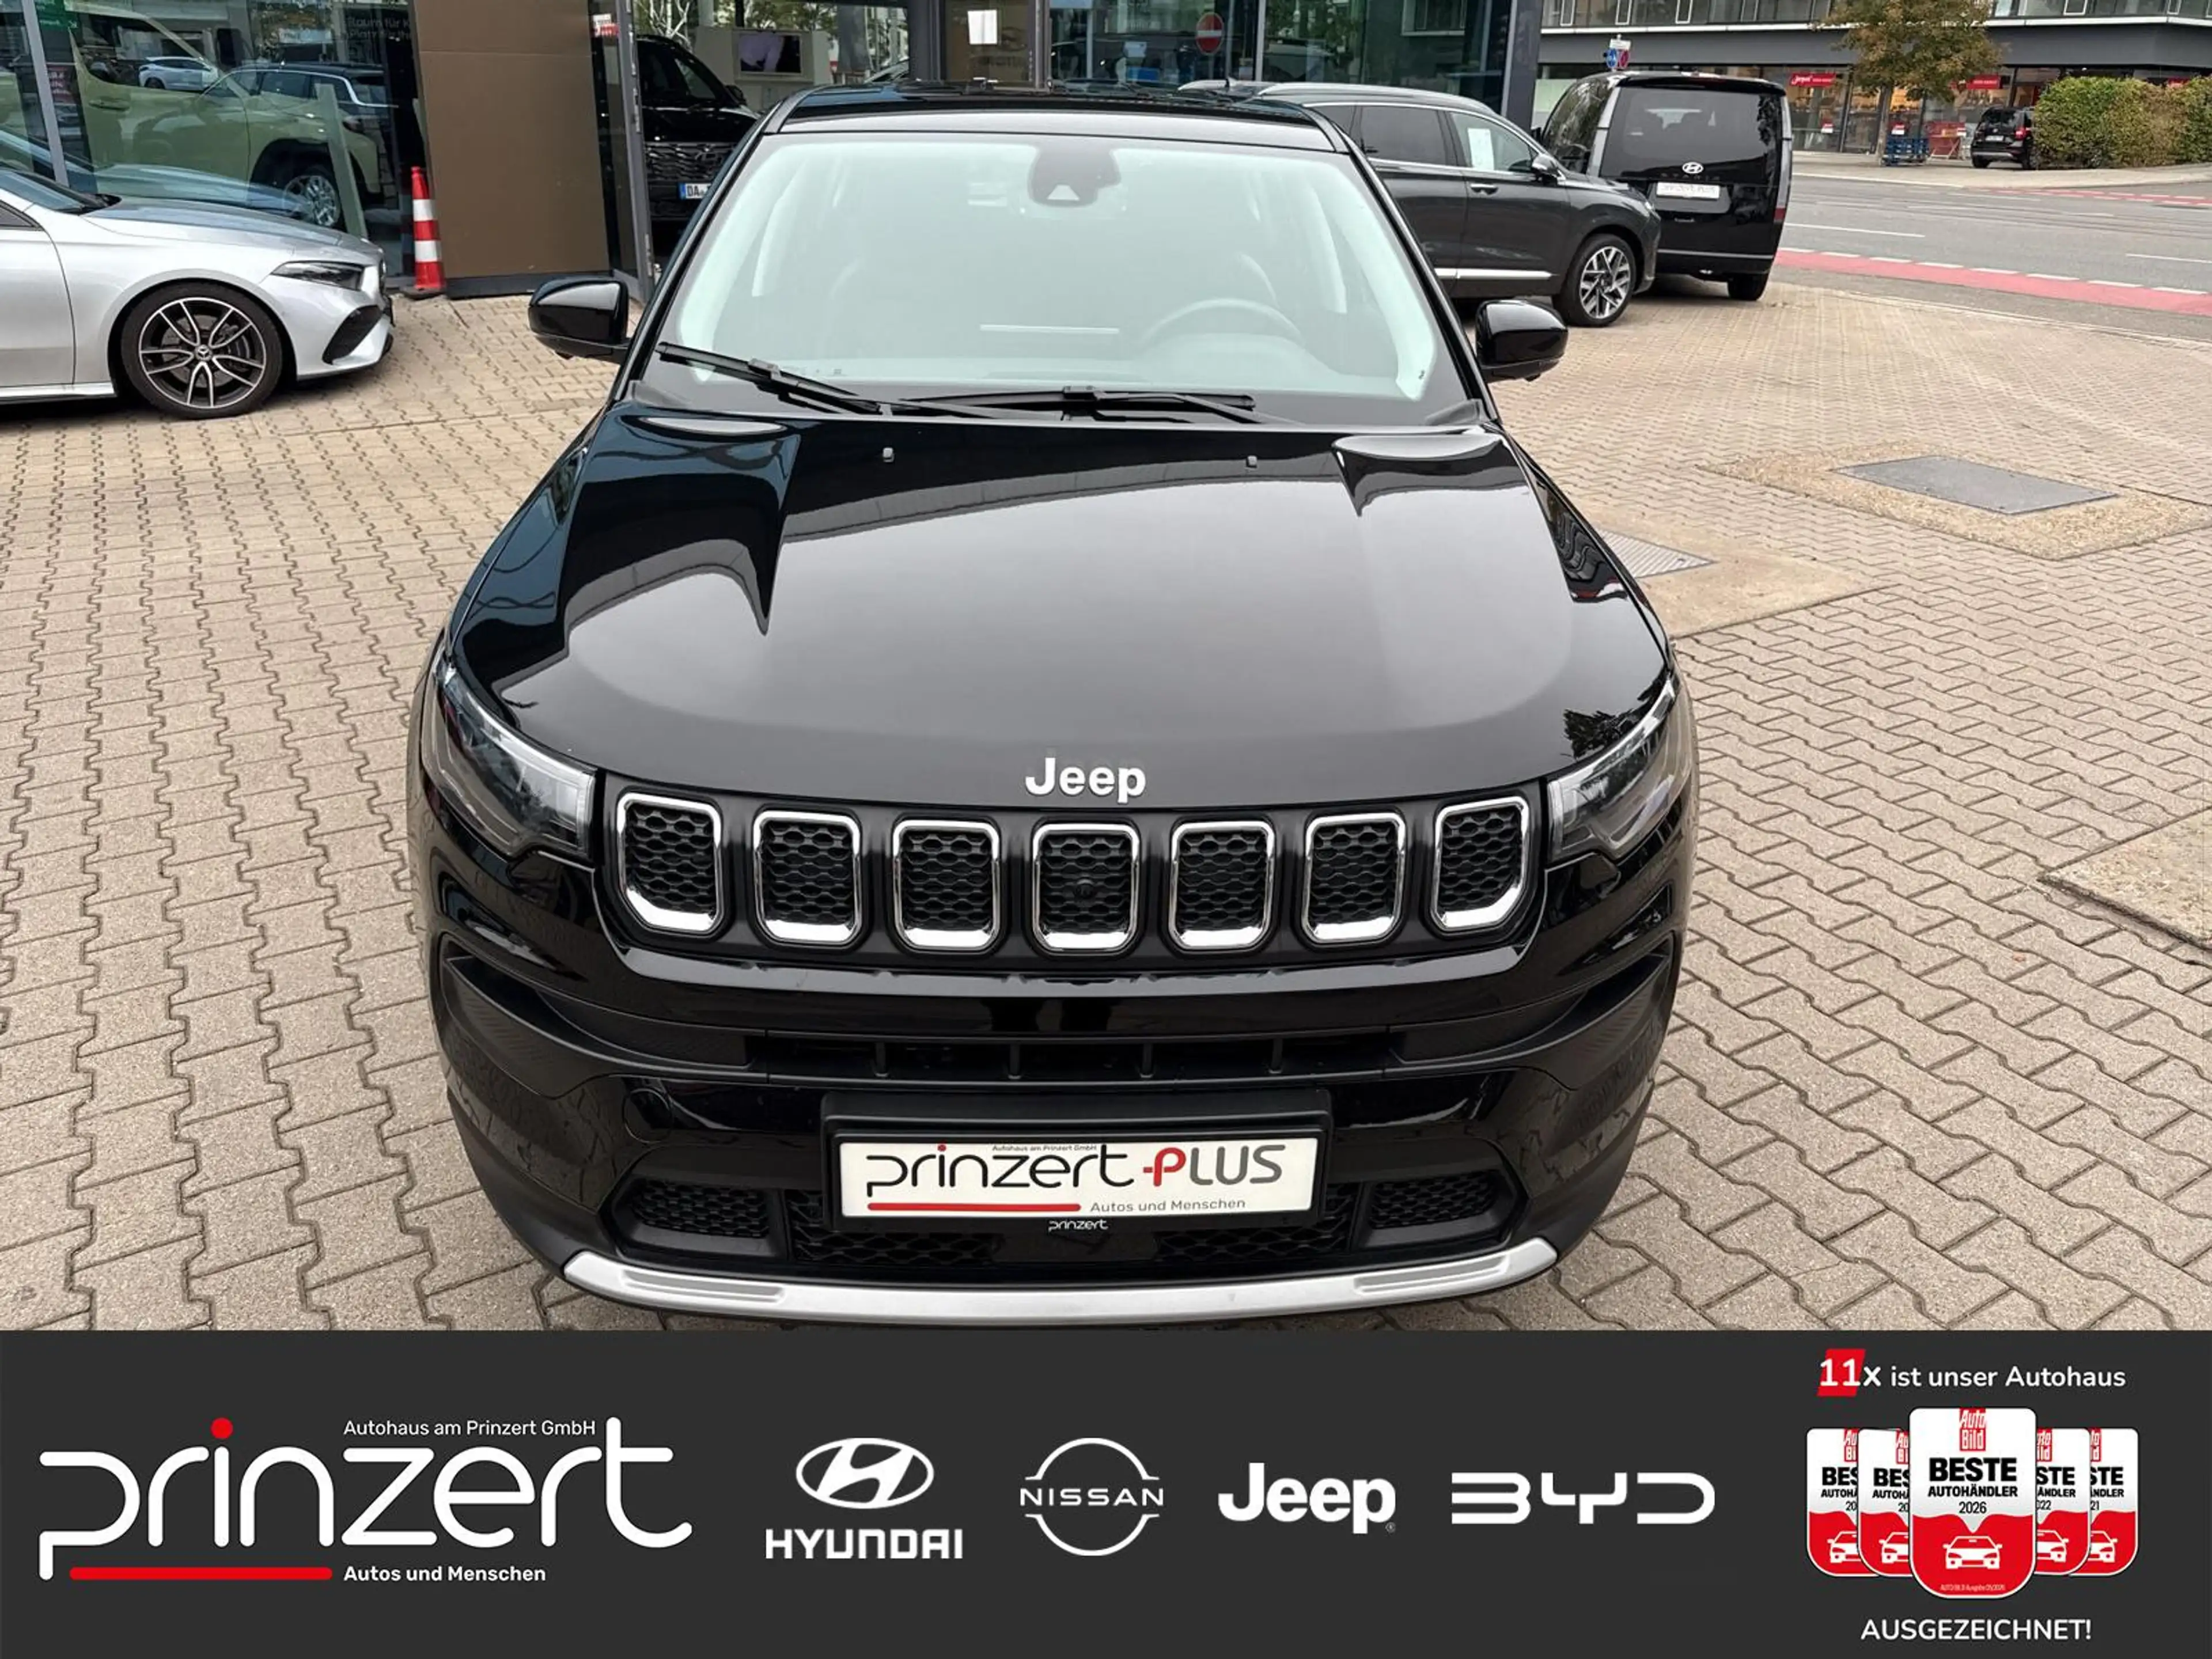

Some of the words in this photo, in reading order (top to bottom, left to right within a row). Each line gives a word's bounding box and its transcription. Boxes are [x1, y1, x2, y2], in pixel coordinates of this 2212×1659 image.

[1025, 757, 1146, 804] Jeep
[866, 1144, 1134, 1197] prinzert
[1090, 1202, 1134, 1213] Autos
[1139, 1200, 1166, 1212] und
[1171, 1199, 1246, 1210] Menschen
[1048, 1219, 1108, 1232] prinzert
